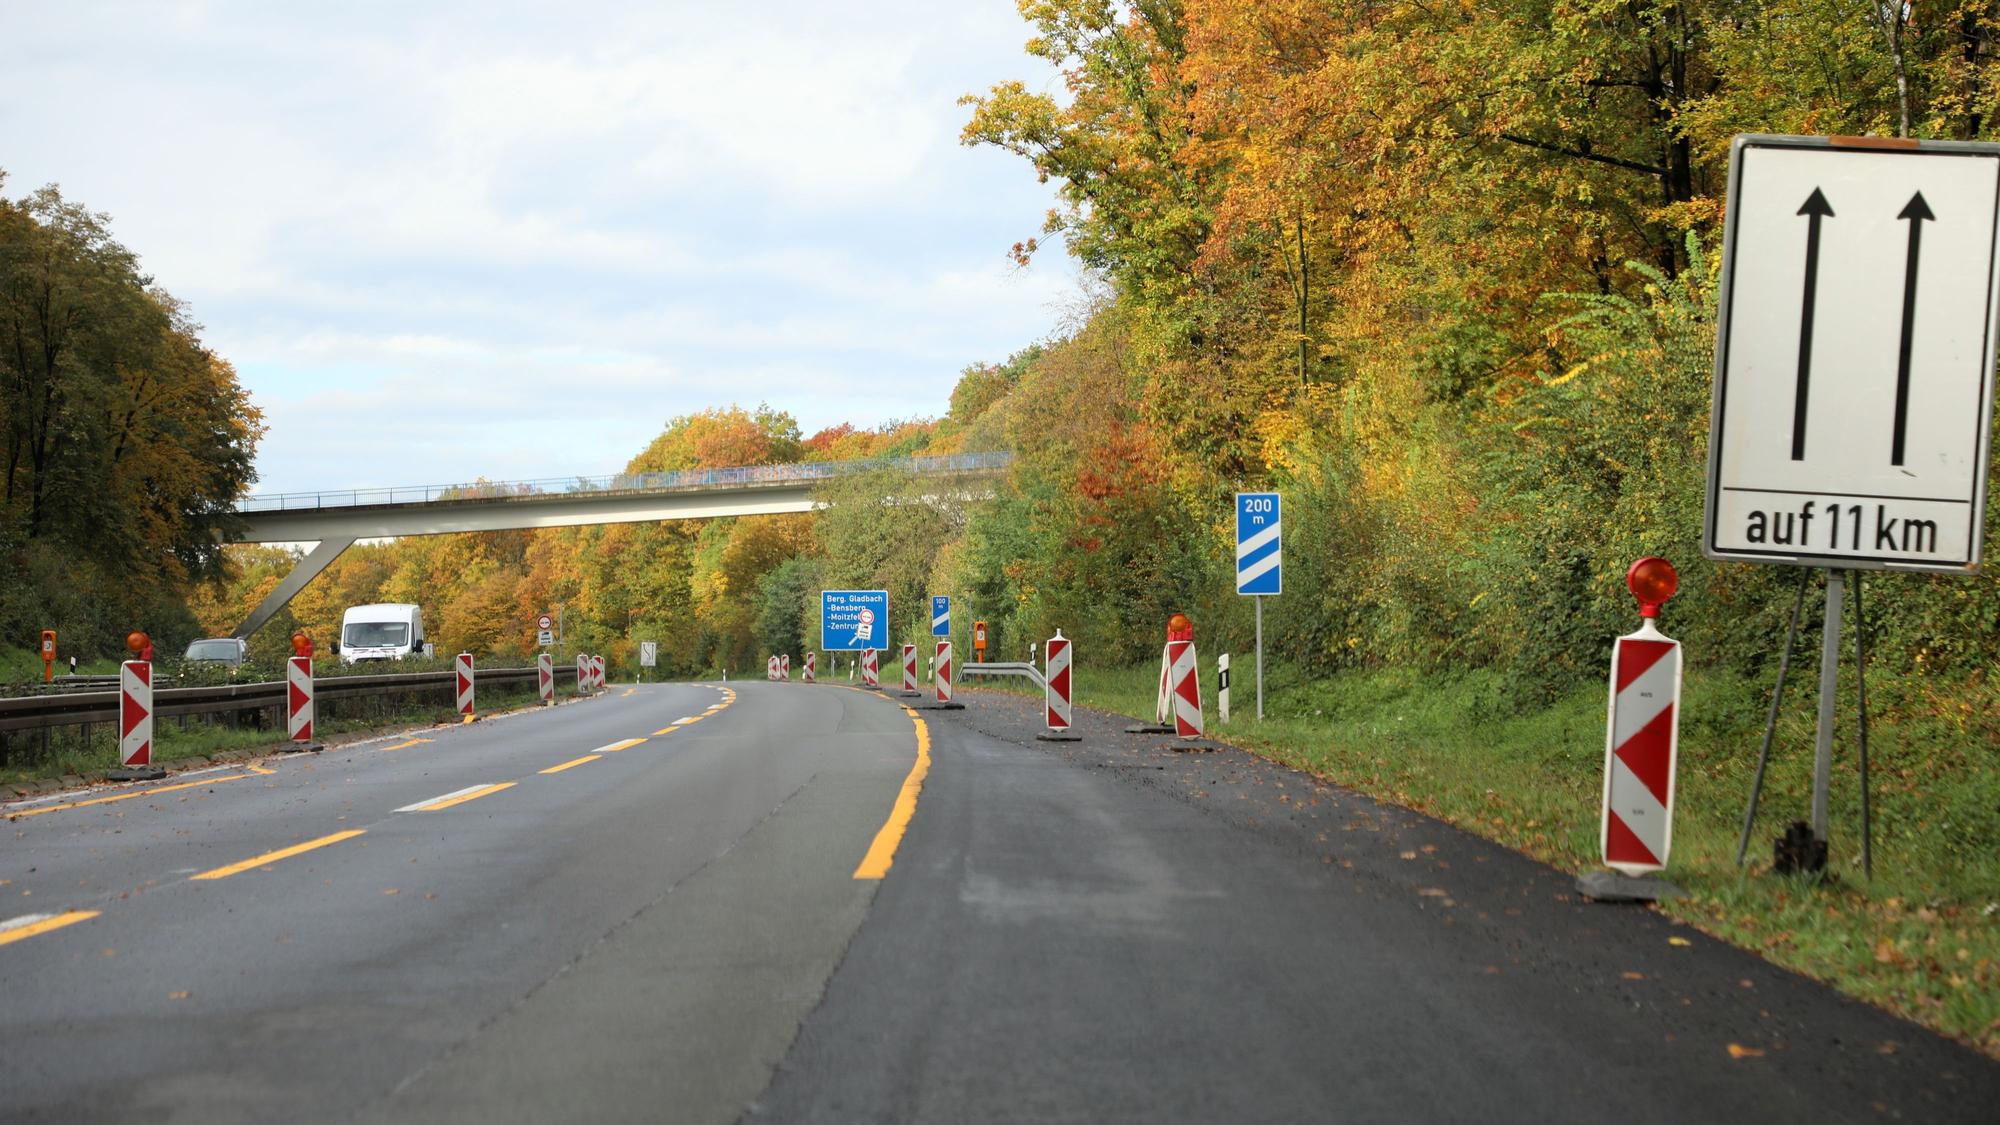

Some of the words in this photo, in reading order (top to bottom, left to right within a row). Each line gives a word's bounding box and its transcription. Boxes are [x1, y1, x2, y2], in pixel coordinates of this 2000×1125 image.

[1245, 498, 1272, 513] 200
[1252, 515, 1265, 525] m
[1746, 501, 1815, 546] auf
[1826, 503, 1863, 550] 11
[1875, 504, 1938, 553] km
[827, 595, 846, 604] Berg.
[849, 595, 883, 603] Gladbach
